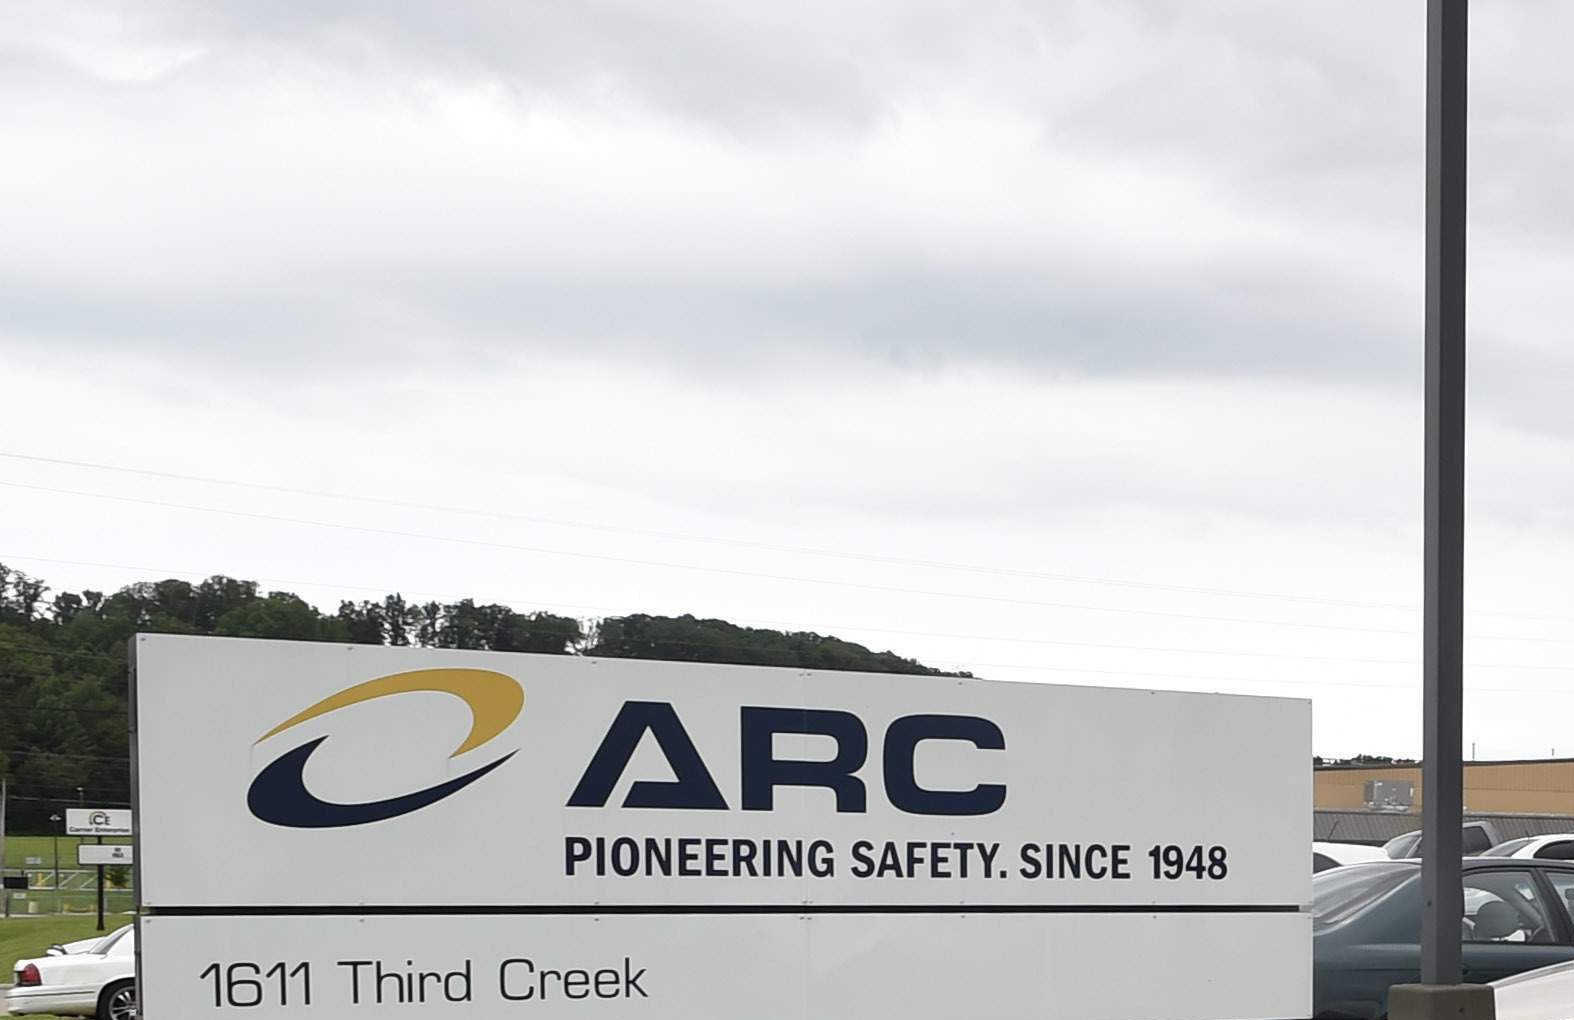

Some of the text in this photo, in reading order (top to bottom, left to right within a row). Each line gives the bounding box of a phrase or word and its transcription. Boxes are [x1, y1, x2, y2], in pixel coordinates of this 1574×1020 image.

[565, 700, 1007, 817] ARC
[565, 836, 1228, 880] PIONEERING SAFETY. SINCE 1948
[199, 957, 648, 1008] 1611 Third Creek
